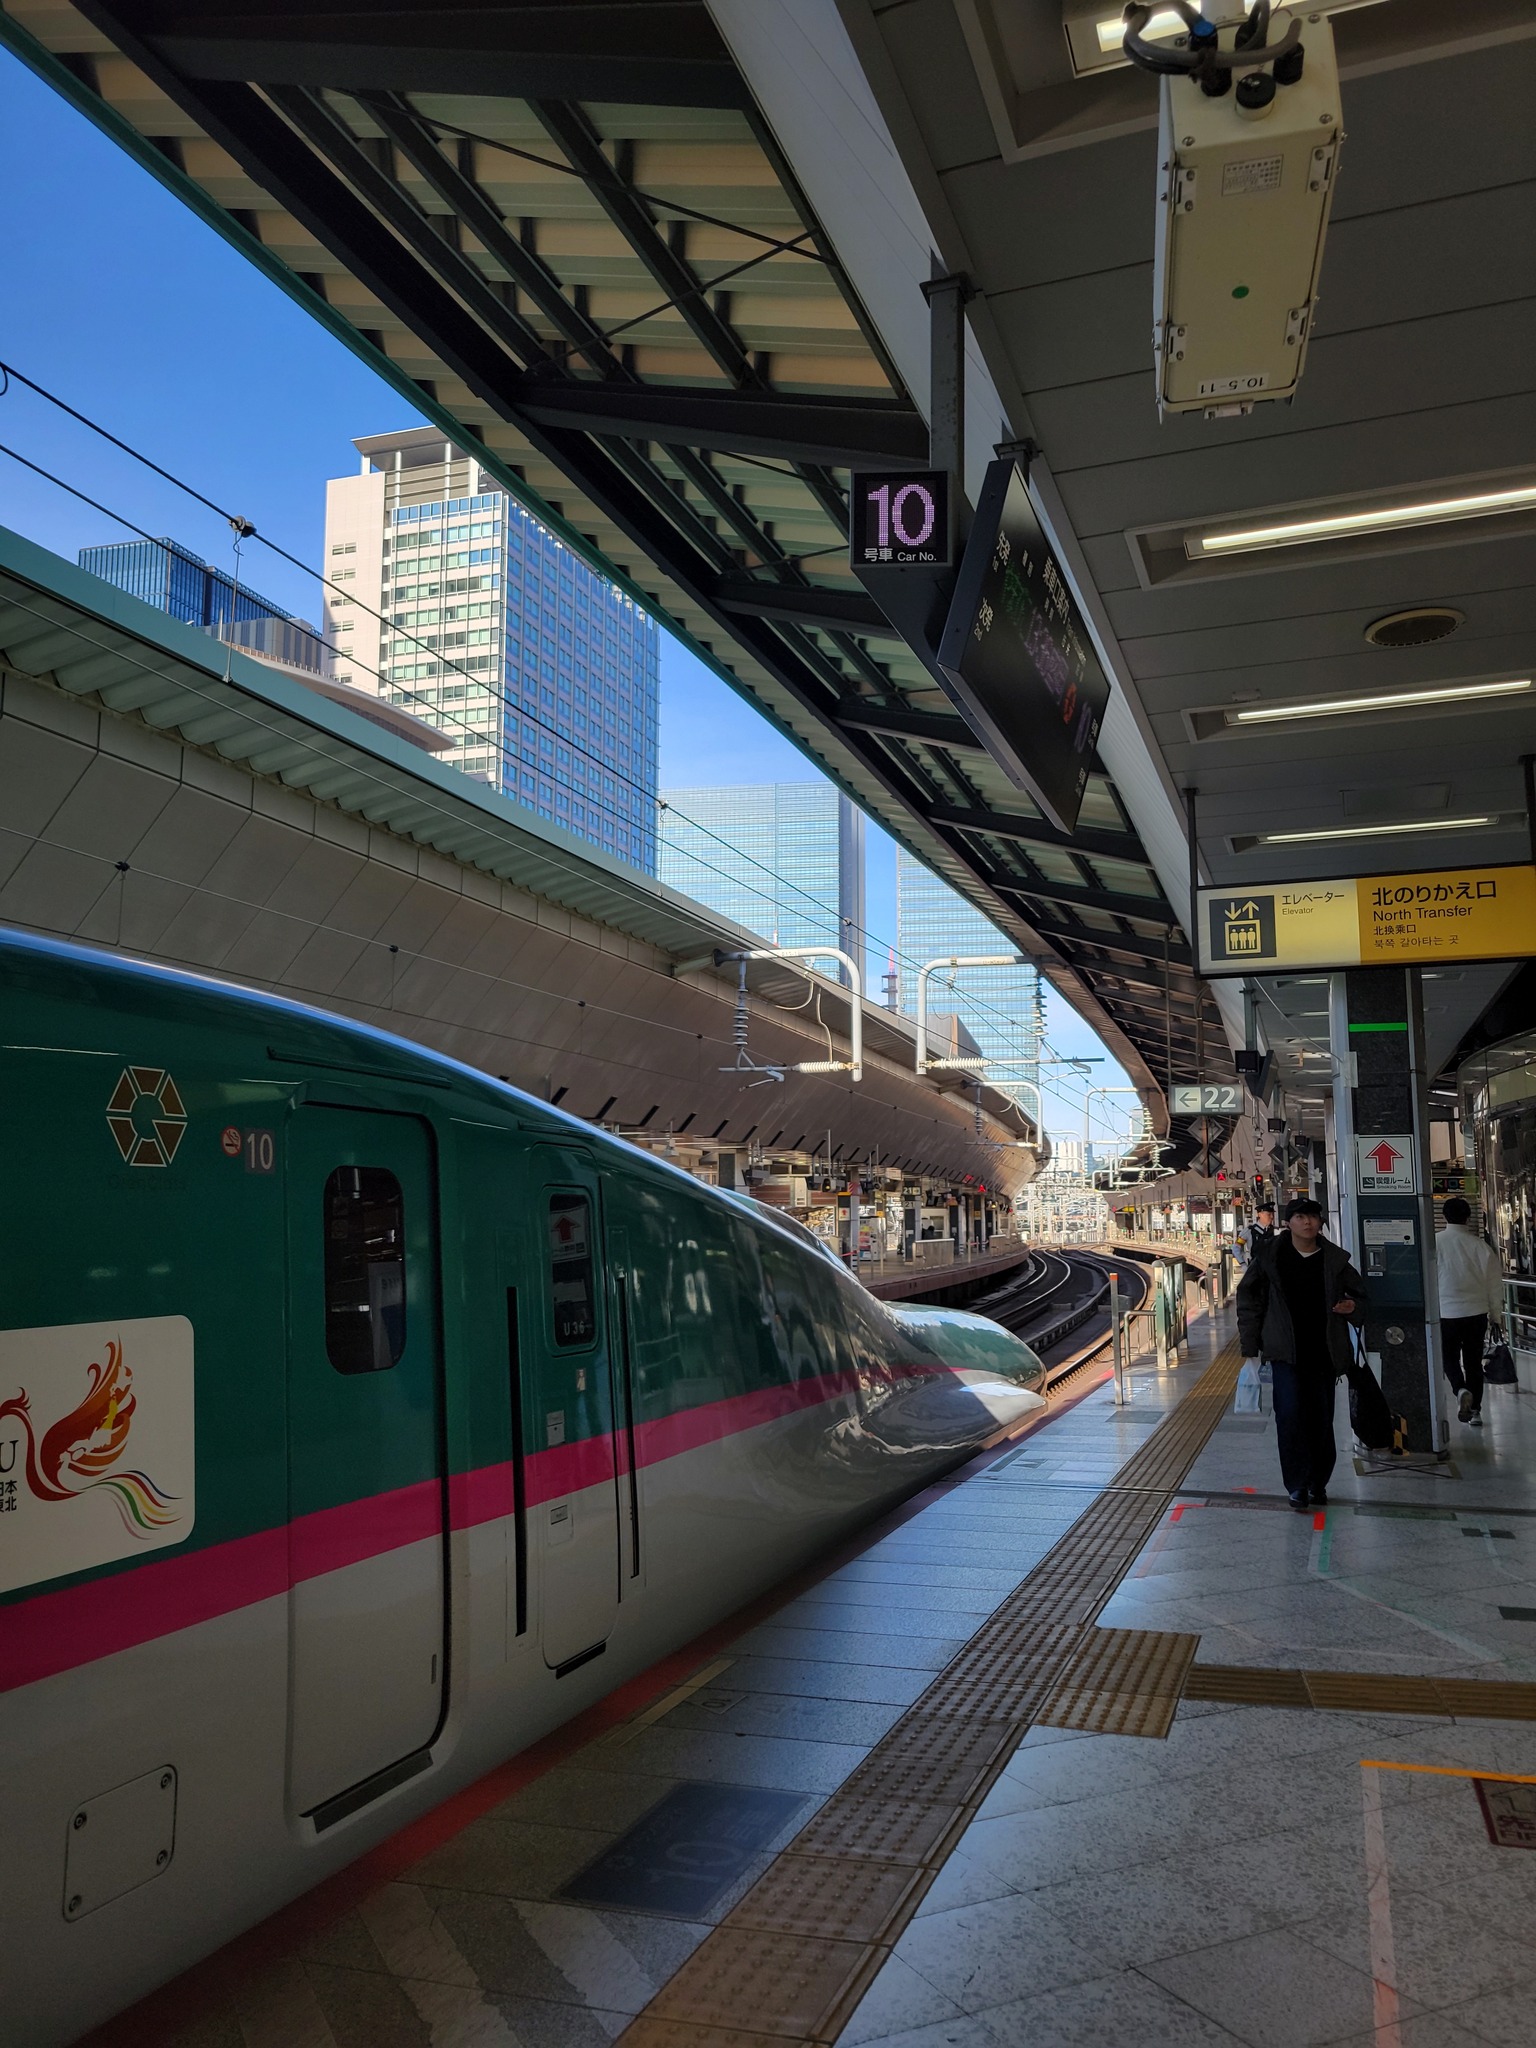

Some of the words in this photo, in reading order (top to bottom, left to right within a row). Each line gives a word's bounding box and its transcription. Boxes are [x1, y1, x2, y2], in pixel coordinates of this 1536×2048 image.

[867, 484, 935, 547] 10
[864, 547, 894, 562] 号車
[897, 551, 917, 562] Car
[918, 551, 937, 562] No.
[996, 529, 1011, 566] 先発
[1042, 556, 1070, 625] 乗車口案内
[979, 597, 994, 632] 次発
[1282, 890, 1345, 906] エレベーター
[1371, 880, 1497, 907] 北のりかえ口
[1282, 906, 1314, 916] Elevator
[1373, 908, 1411, 922] North
[1415, 905, 1473, 918] Transfer
[1373, 923, 1416, 936] 北換乗口
[1373, 938, 1395, 949] 북쪽
[1399, 934, 1443, 948] 갈아타는
[1449, 934, 1459, 945] 곳
[1204, 1086, 1236, 1109] 22
[247, 1132, 274, 1170] 10
[903, 1186, 912, 1195] 21
[1433, 1179, 1465, 1188] KIOS
